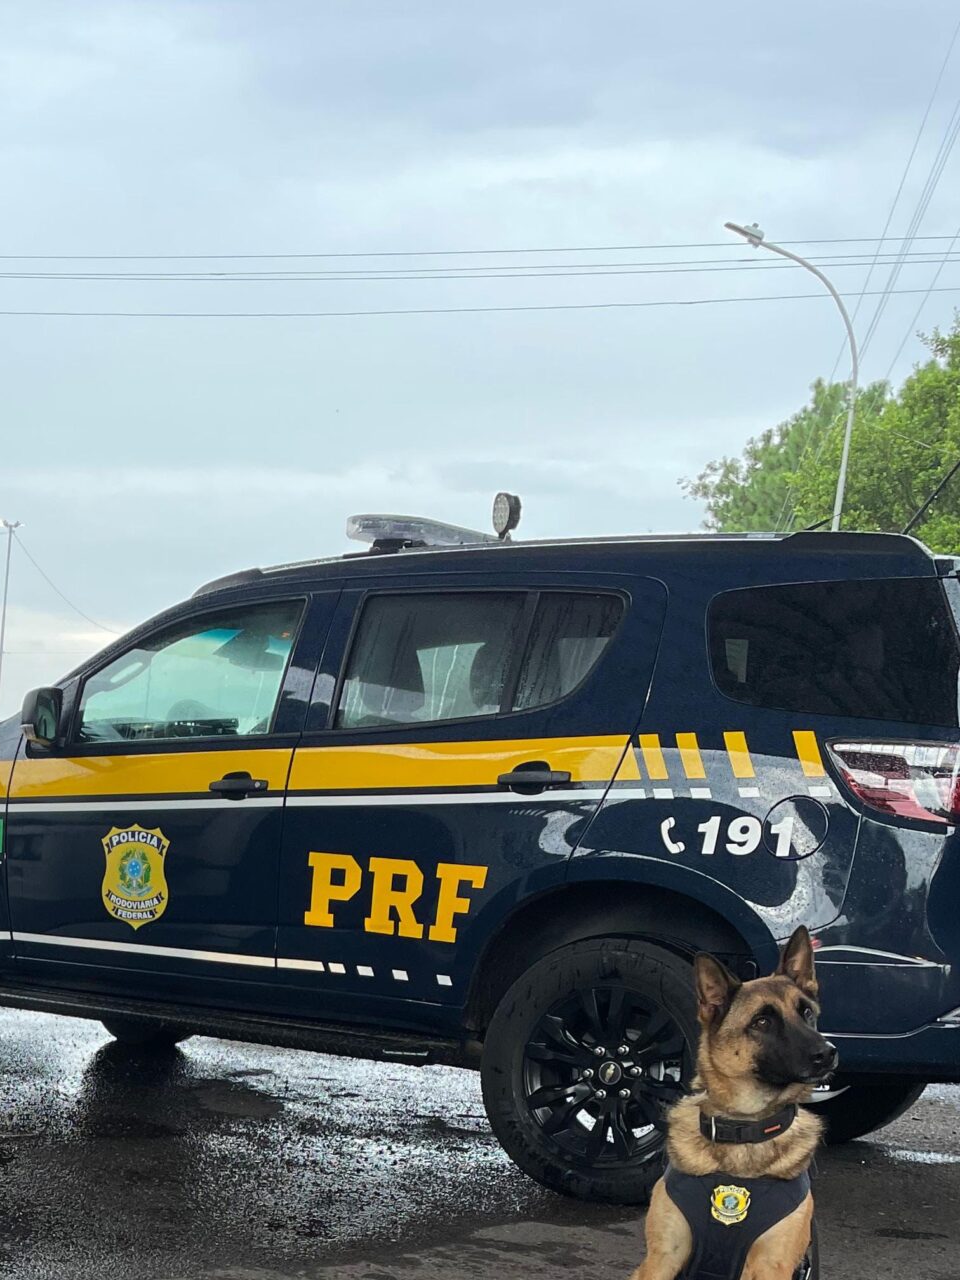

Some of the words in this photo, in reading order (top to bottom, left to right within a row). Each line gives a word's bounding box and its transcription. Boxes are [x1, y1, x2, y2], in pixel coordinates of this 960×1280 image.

[697, 815, 794, 857] 191
[117, 909, 153, 920] FEDERAL
[304, 851, 488, 943] PRF
